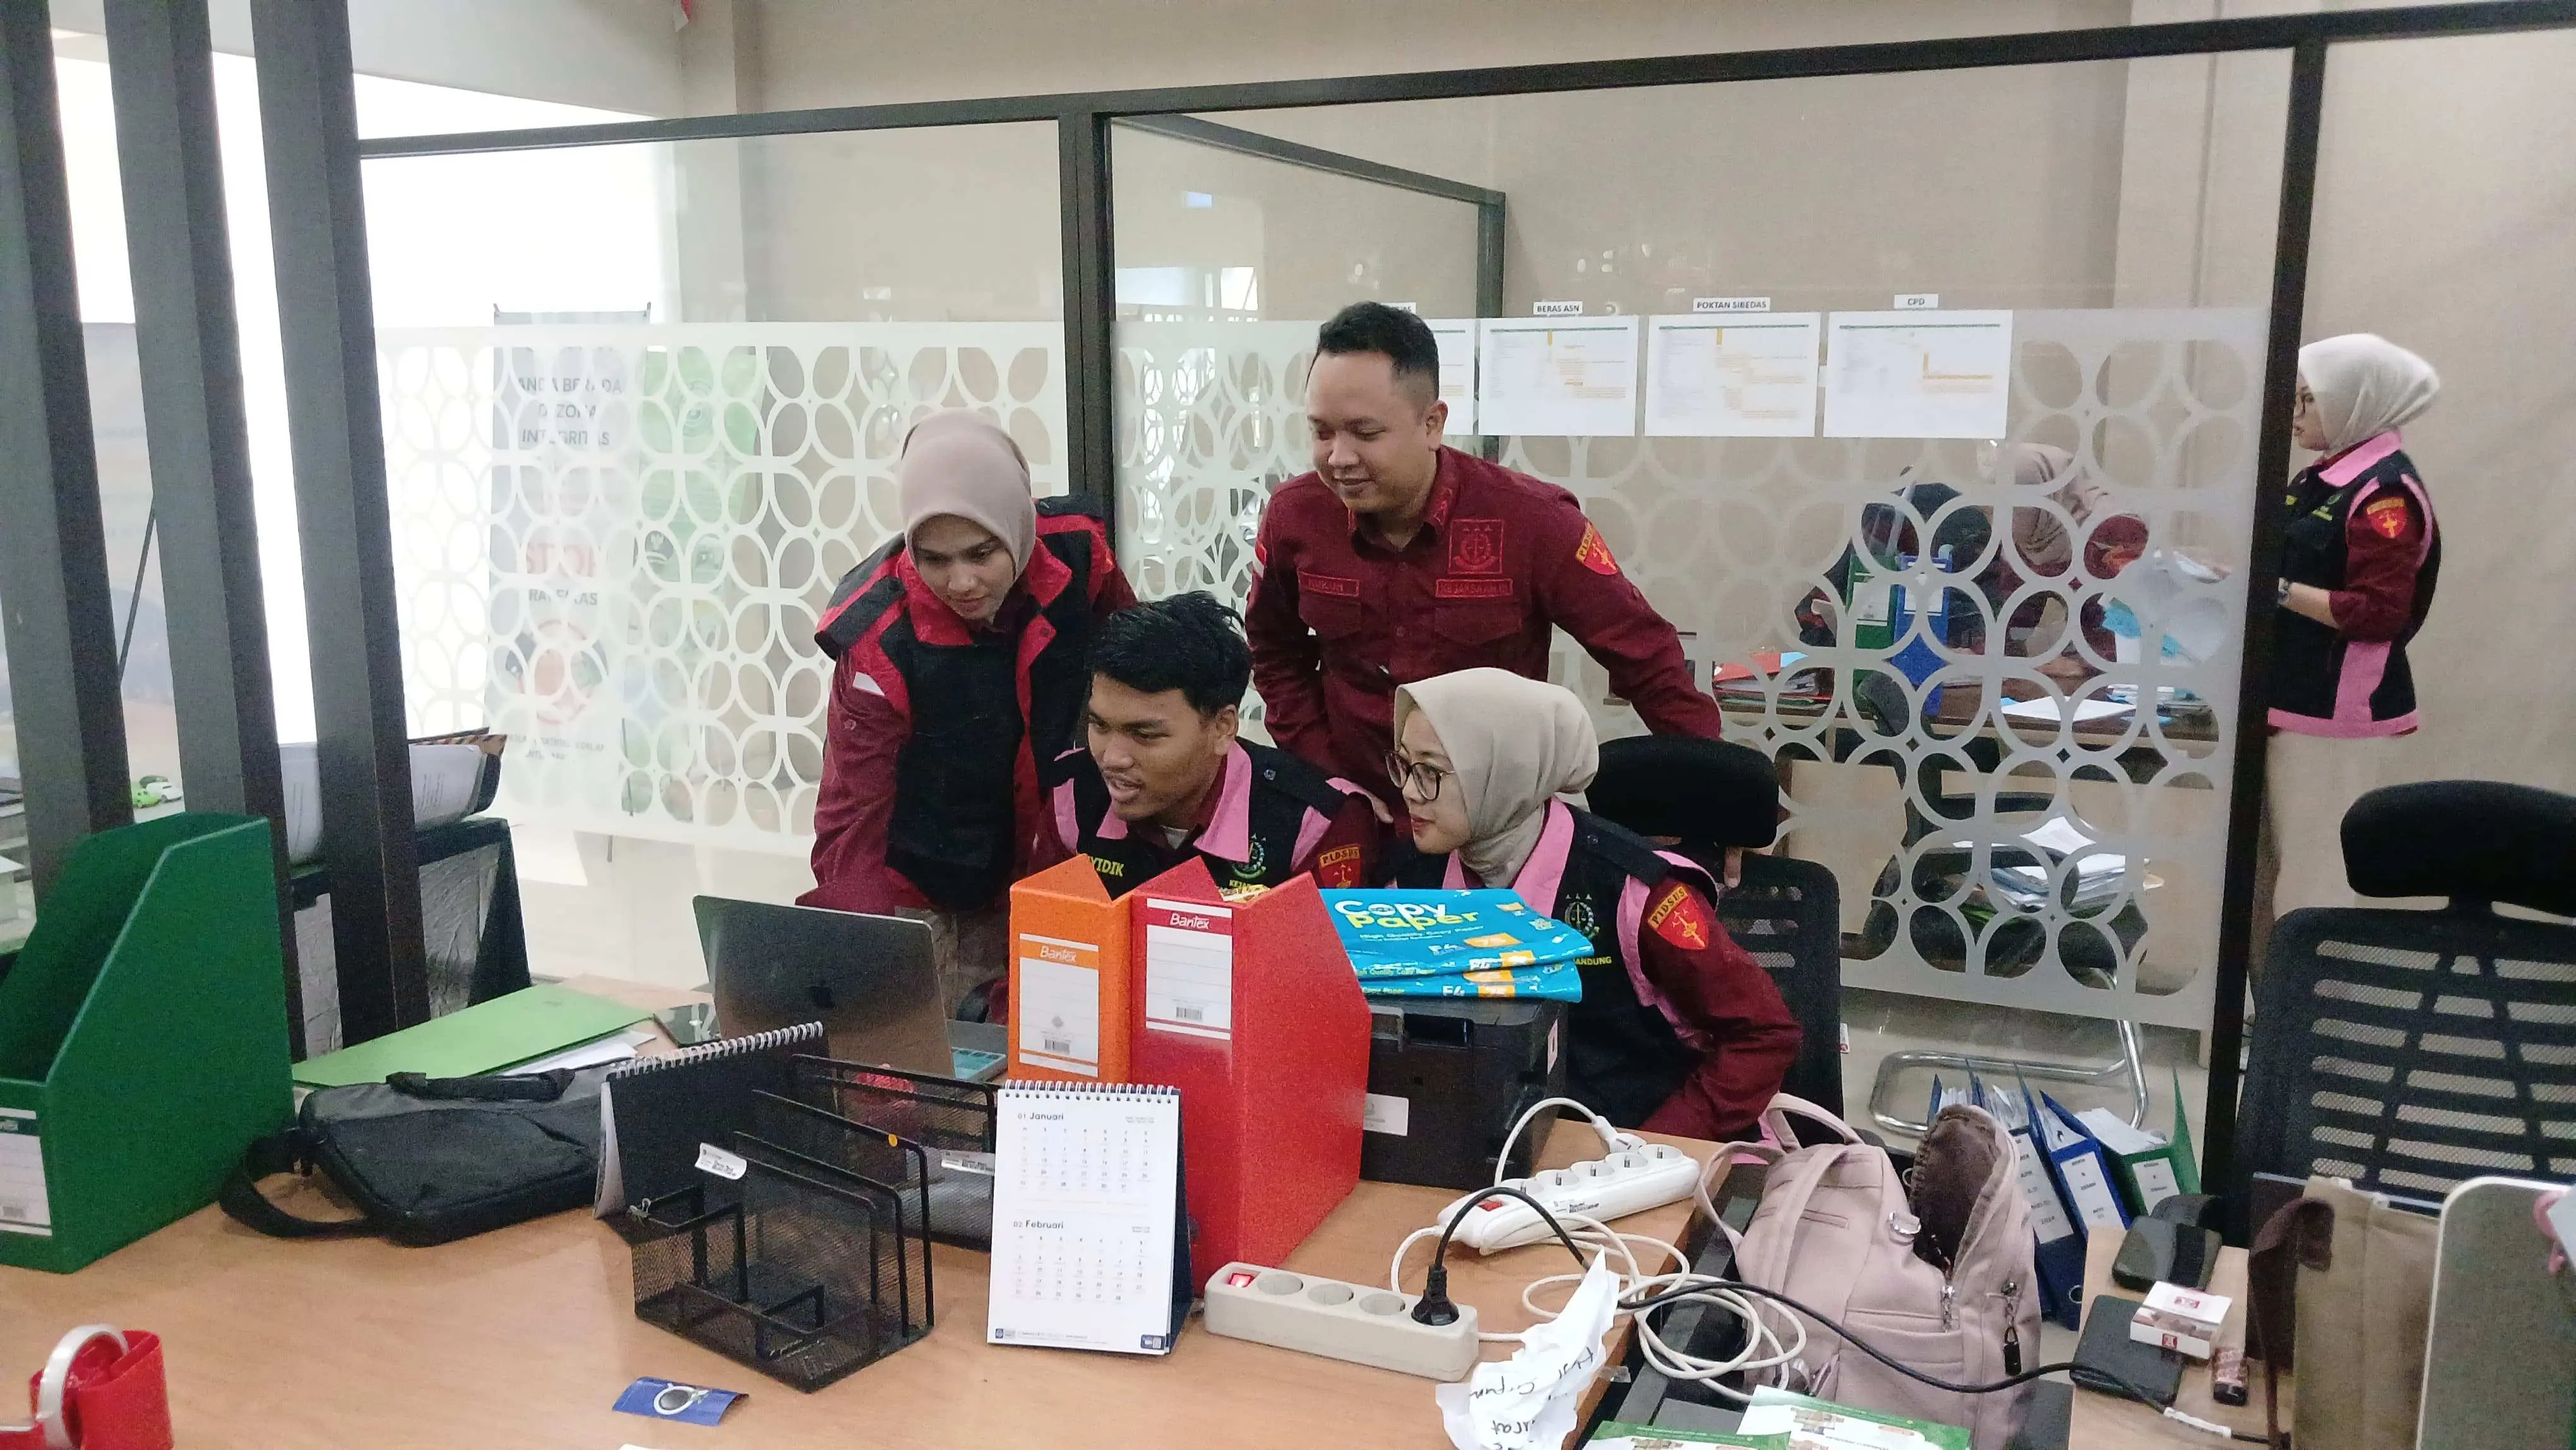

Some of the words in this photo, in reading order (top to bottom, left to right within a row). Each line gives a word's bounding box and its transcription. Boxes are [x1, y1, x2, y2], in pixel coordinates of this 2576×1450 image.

[563, 377, 623, 394] BERDA
[522, 429, 611, 446] INTGRITS
[1333, 900, 1447, 920] Copy
[1651, 887, 1685, 925] PIDSUS
[1169, 913, 1210, 930] Bantex
[1040, 944, 1077, 963] Bantex
[1573, 956, 1613, 966] ANDUNG
[1442, 985, 1465, 997] F4
[1030, 1111, 1064, 1120] Januari
[1025, 1219, 1064, 1229] Februari
